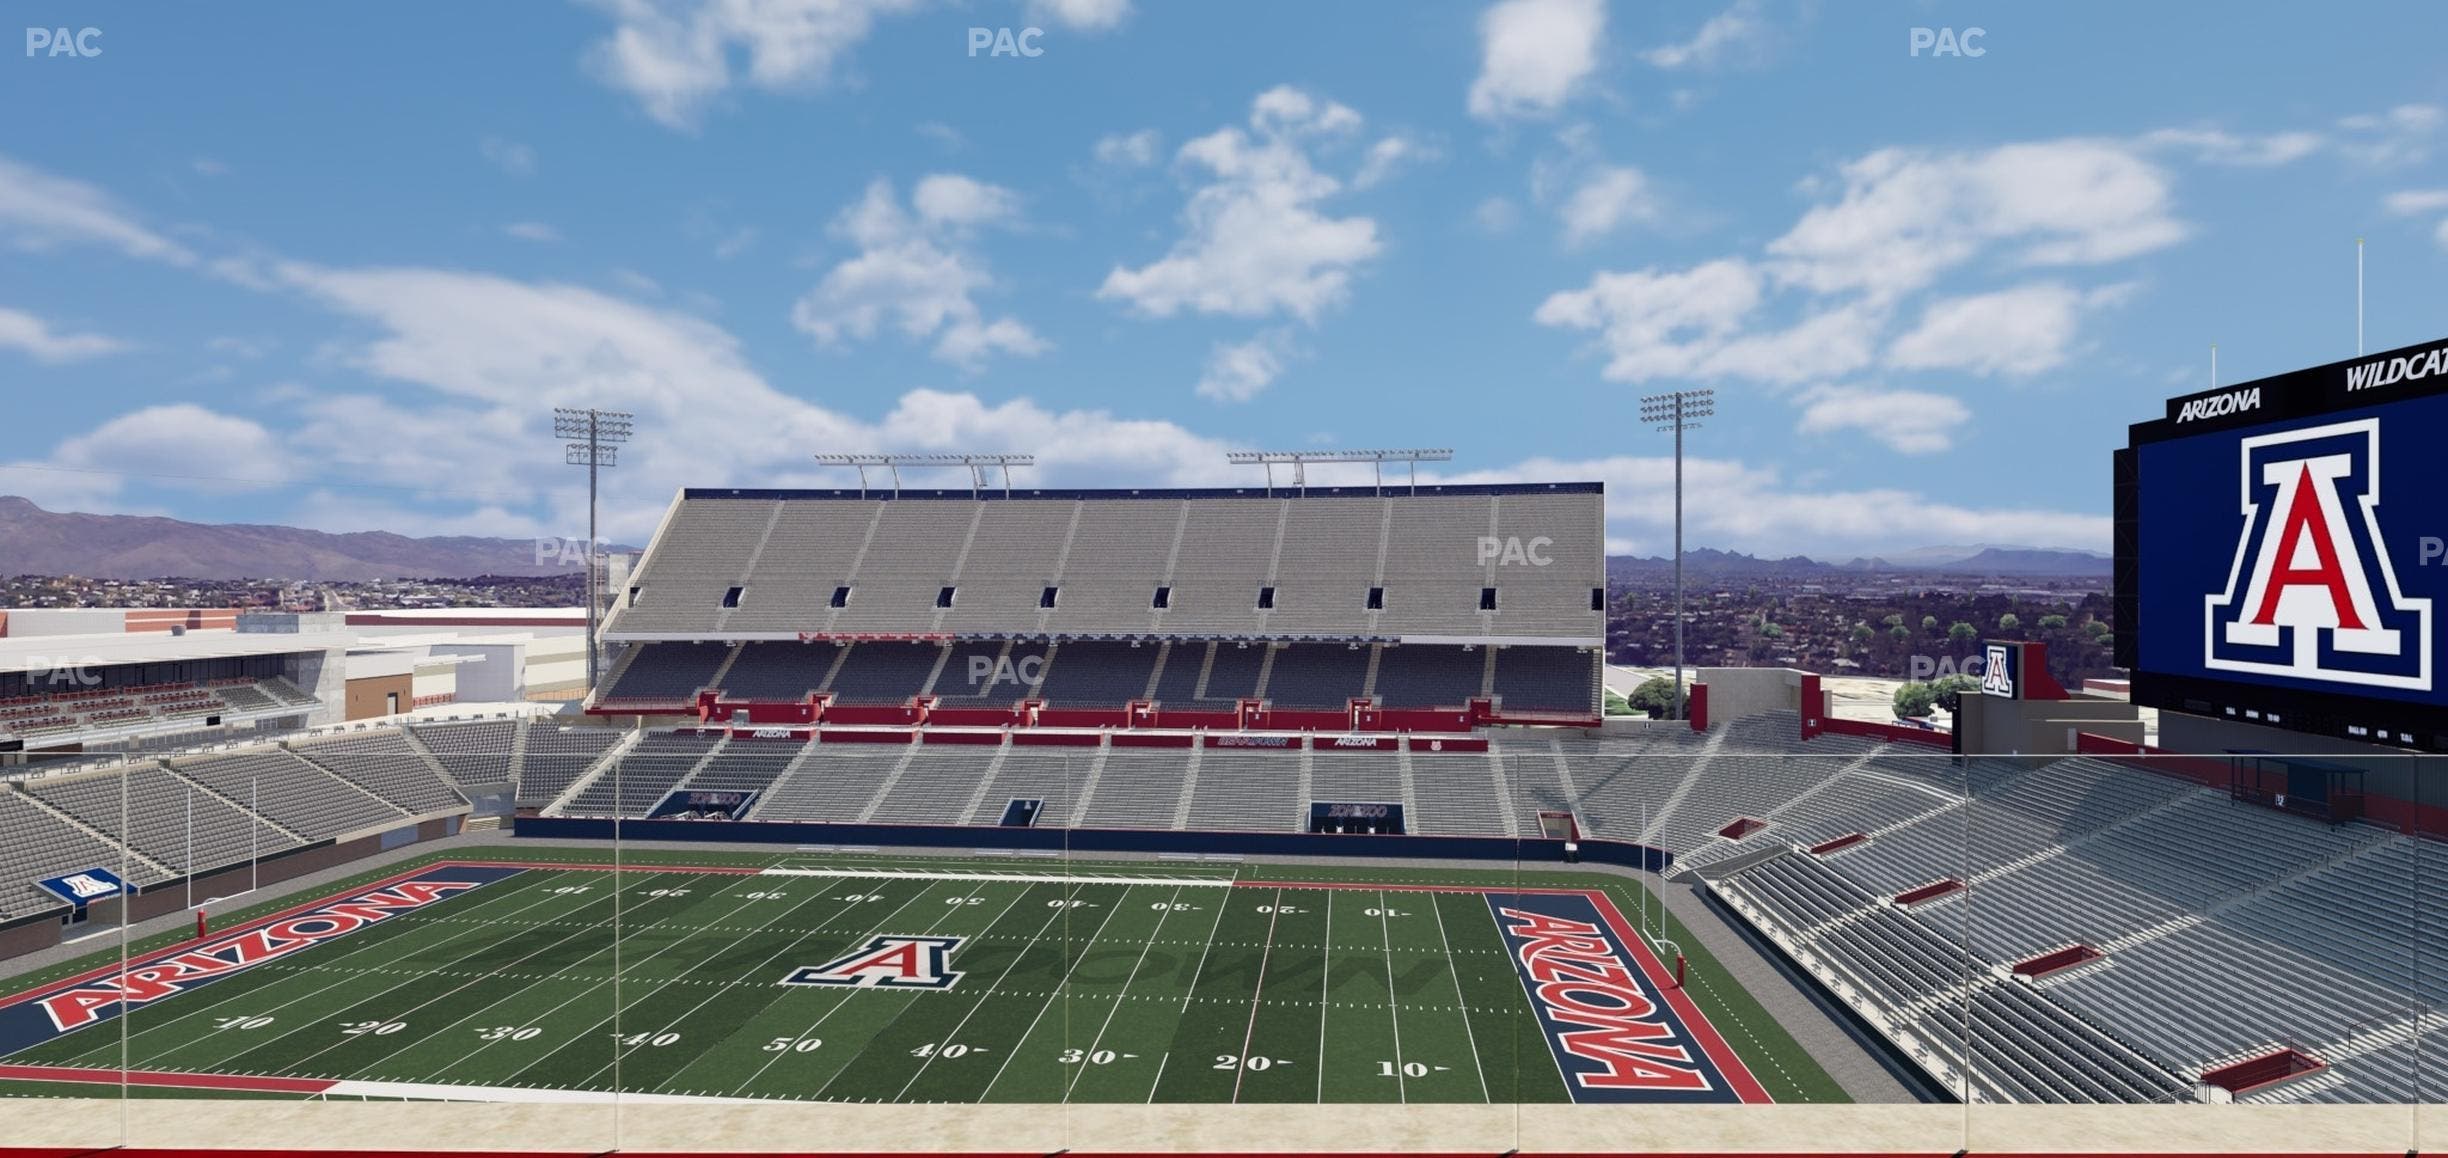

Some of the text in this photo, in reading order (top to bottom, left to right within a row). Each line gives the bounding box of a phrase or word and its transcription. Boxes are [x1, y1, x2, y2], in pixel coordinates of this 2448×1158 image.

[2176, 387, 2261, 424] ARIZONA
[2205, 417, 2432, 691] A
[1981, 645, 2012, 699] A
[752, 729, 792, 738] ARIZONA
[1334, 737, 1377, 747] ARIZONA
[32, 881, 483, 1032] ARIZONA
[777, 934, 971, 991] A
[1499, 907, 1714, 1091] ARIZONA
[213, 1015, 275, 1030] 10
[341, 1020, 408, 1035] 20
[480, 1026, 542, 1041] 30
[621, 1031, 681, 1047] 40
[762, 1037, 823, 1052] 50
[909, 1043, 969, 1058] 40
[1058, 1048, 1117, 1065] 30
[1212, 1054, 1272, 1072] 20
[1376, 1060, 1429, 1078] 10
